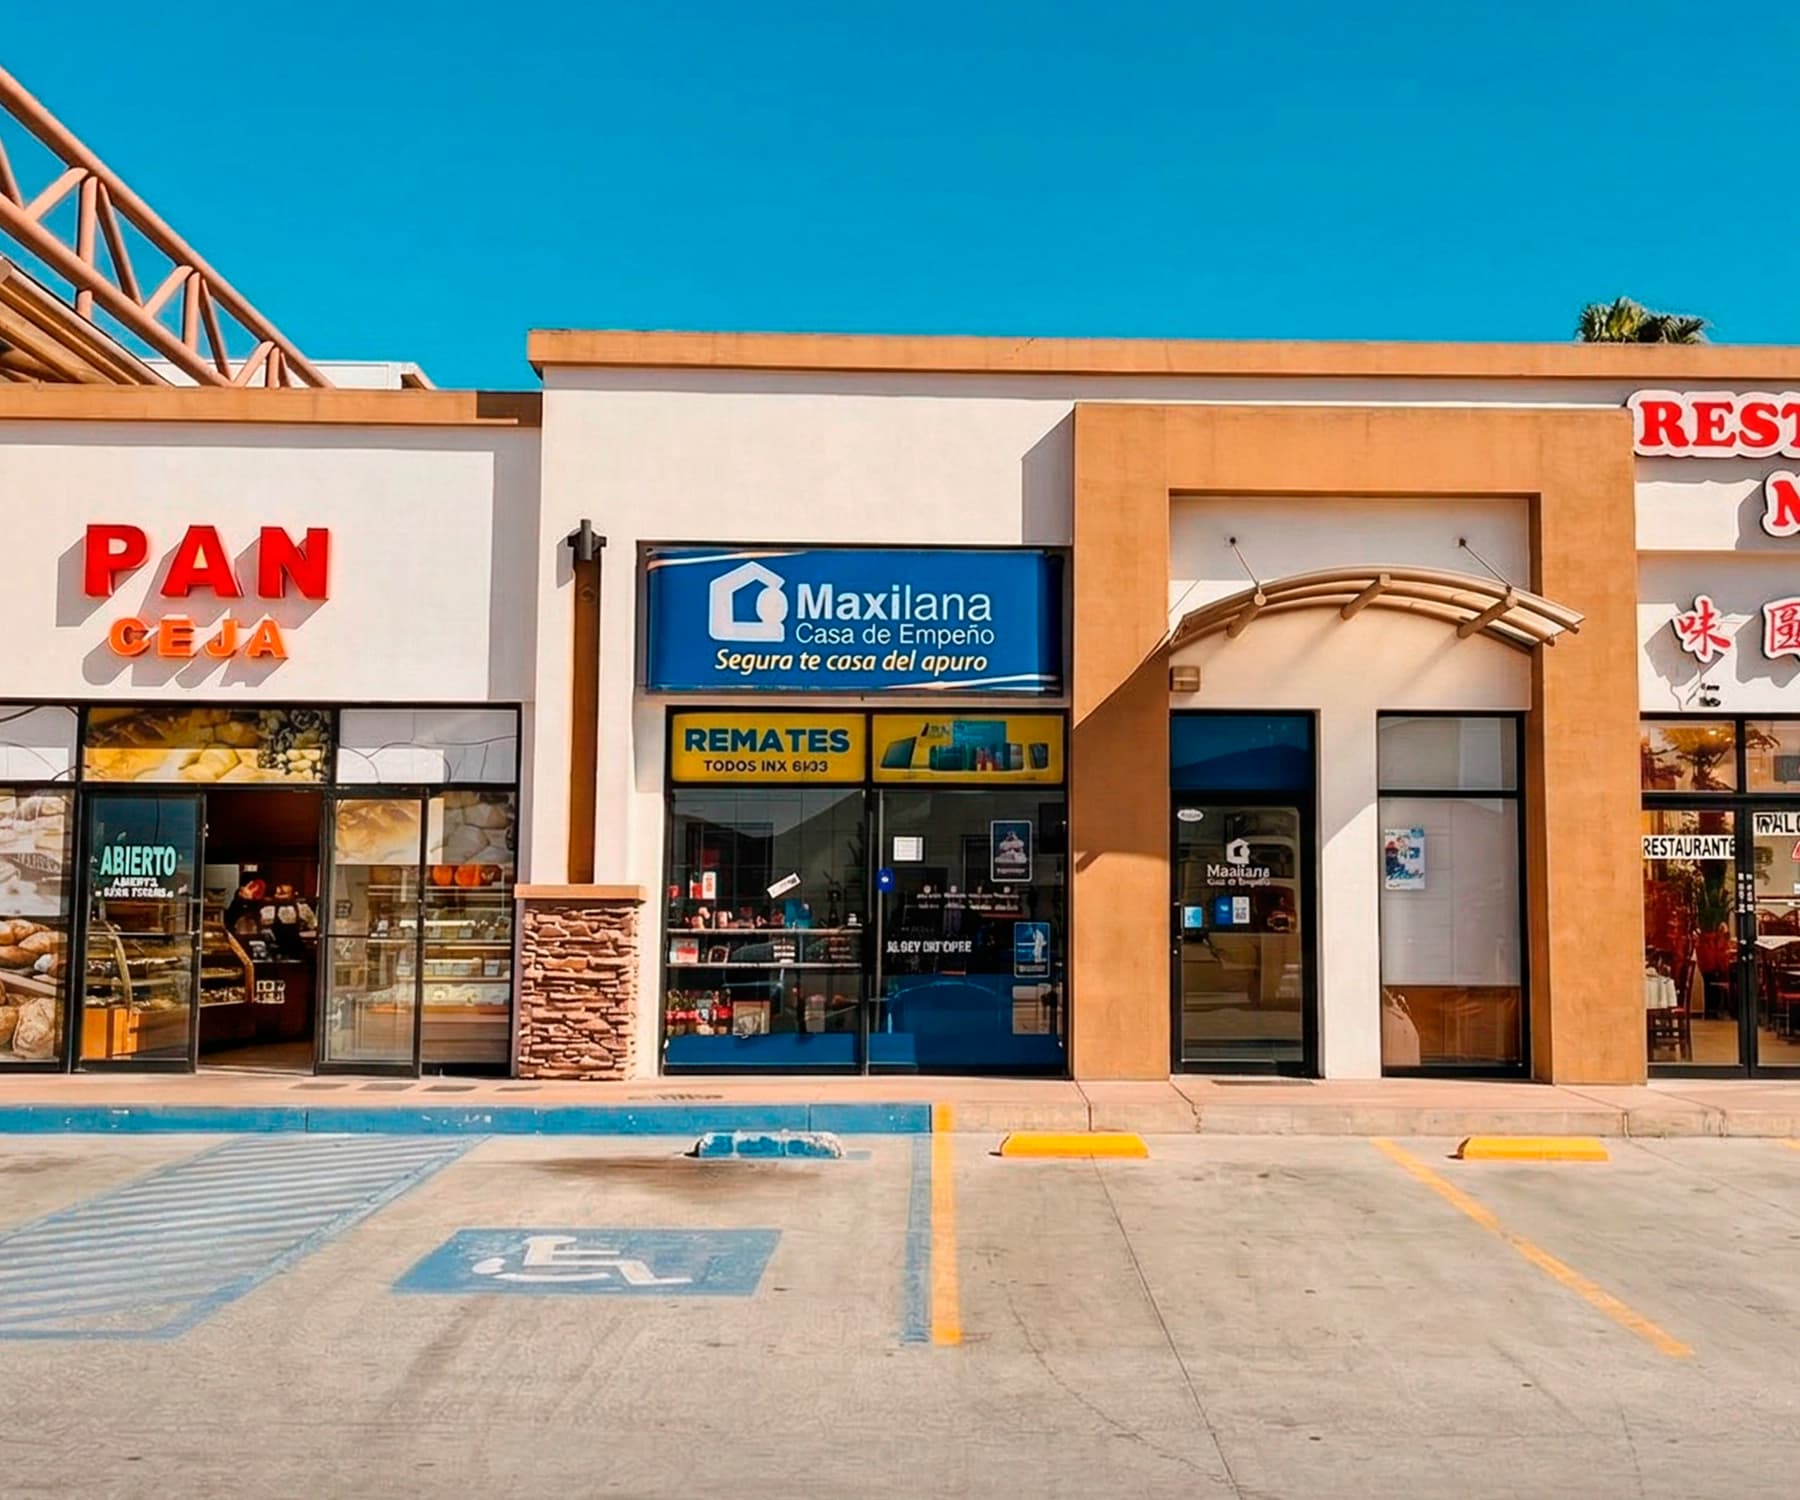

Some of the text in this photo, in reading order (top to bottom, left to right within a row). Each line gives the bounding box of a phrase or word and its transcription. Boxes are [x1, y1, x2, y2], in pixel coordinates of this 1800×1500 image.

[84, 523, 330, 601] PAN
[797, 584, 992, 621] Maxilana
[108, 617, 289, 659] CEJA
[795, 623, 996, 650] Casa de Empeño
[715, 648, 794, 676] Segura
[799, 652, 822, 672] te
[881, 649, 917, 672] del
[921, 653, 989, 677] apuro
[684, 728, 851, 753] REMATES
[704, 760, 757, 773] TODOS
[100, 845, 176, 877] ABIERTO
